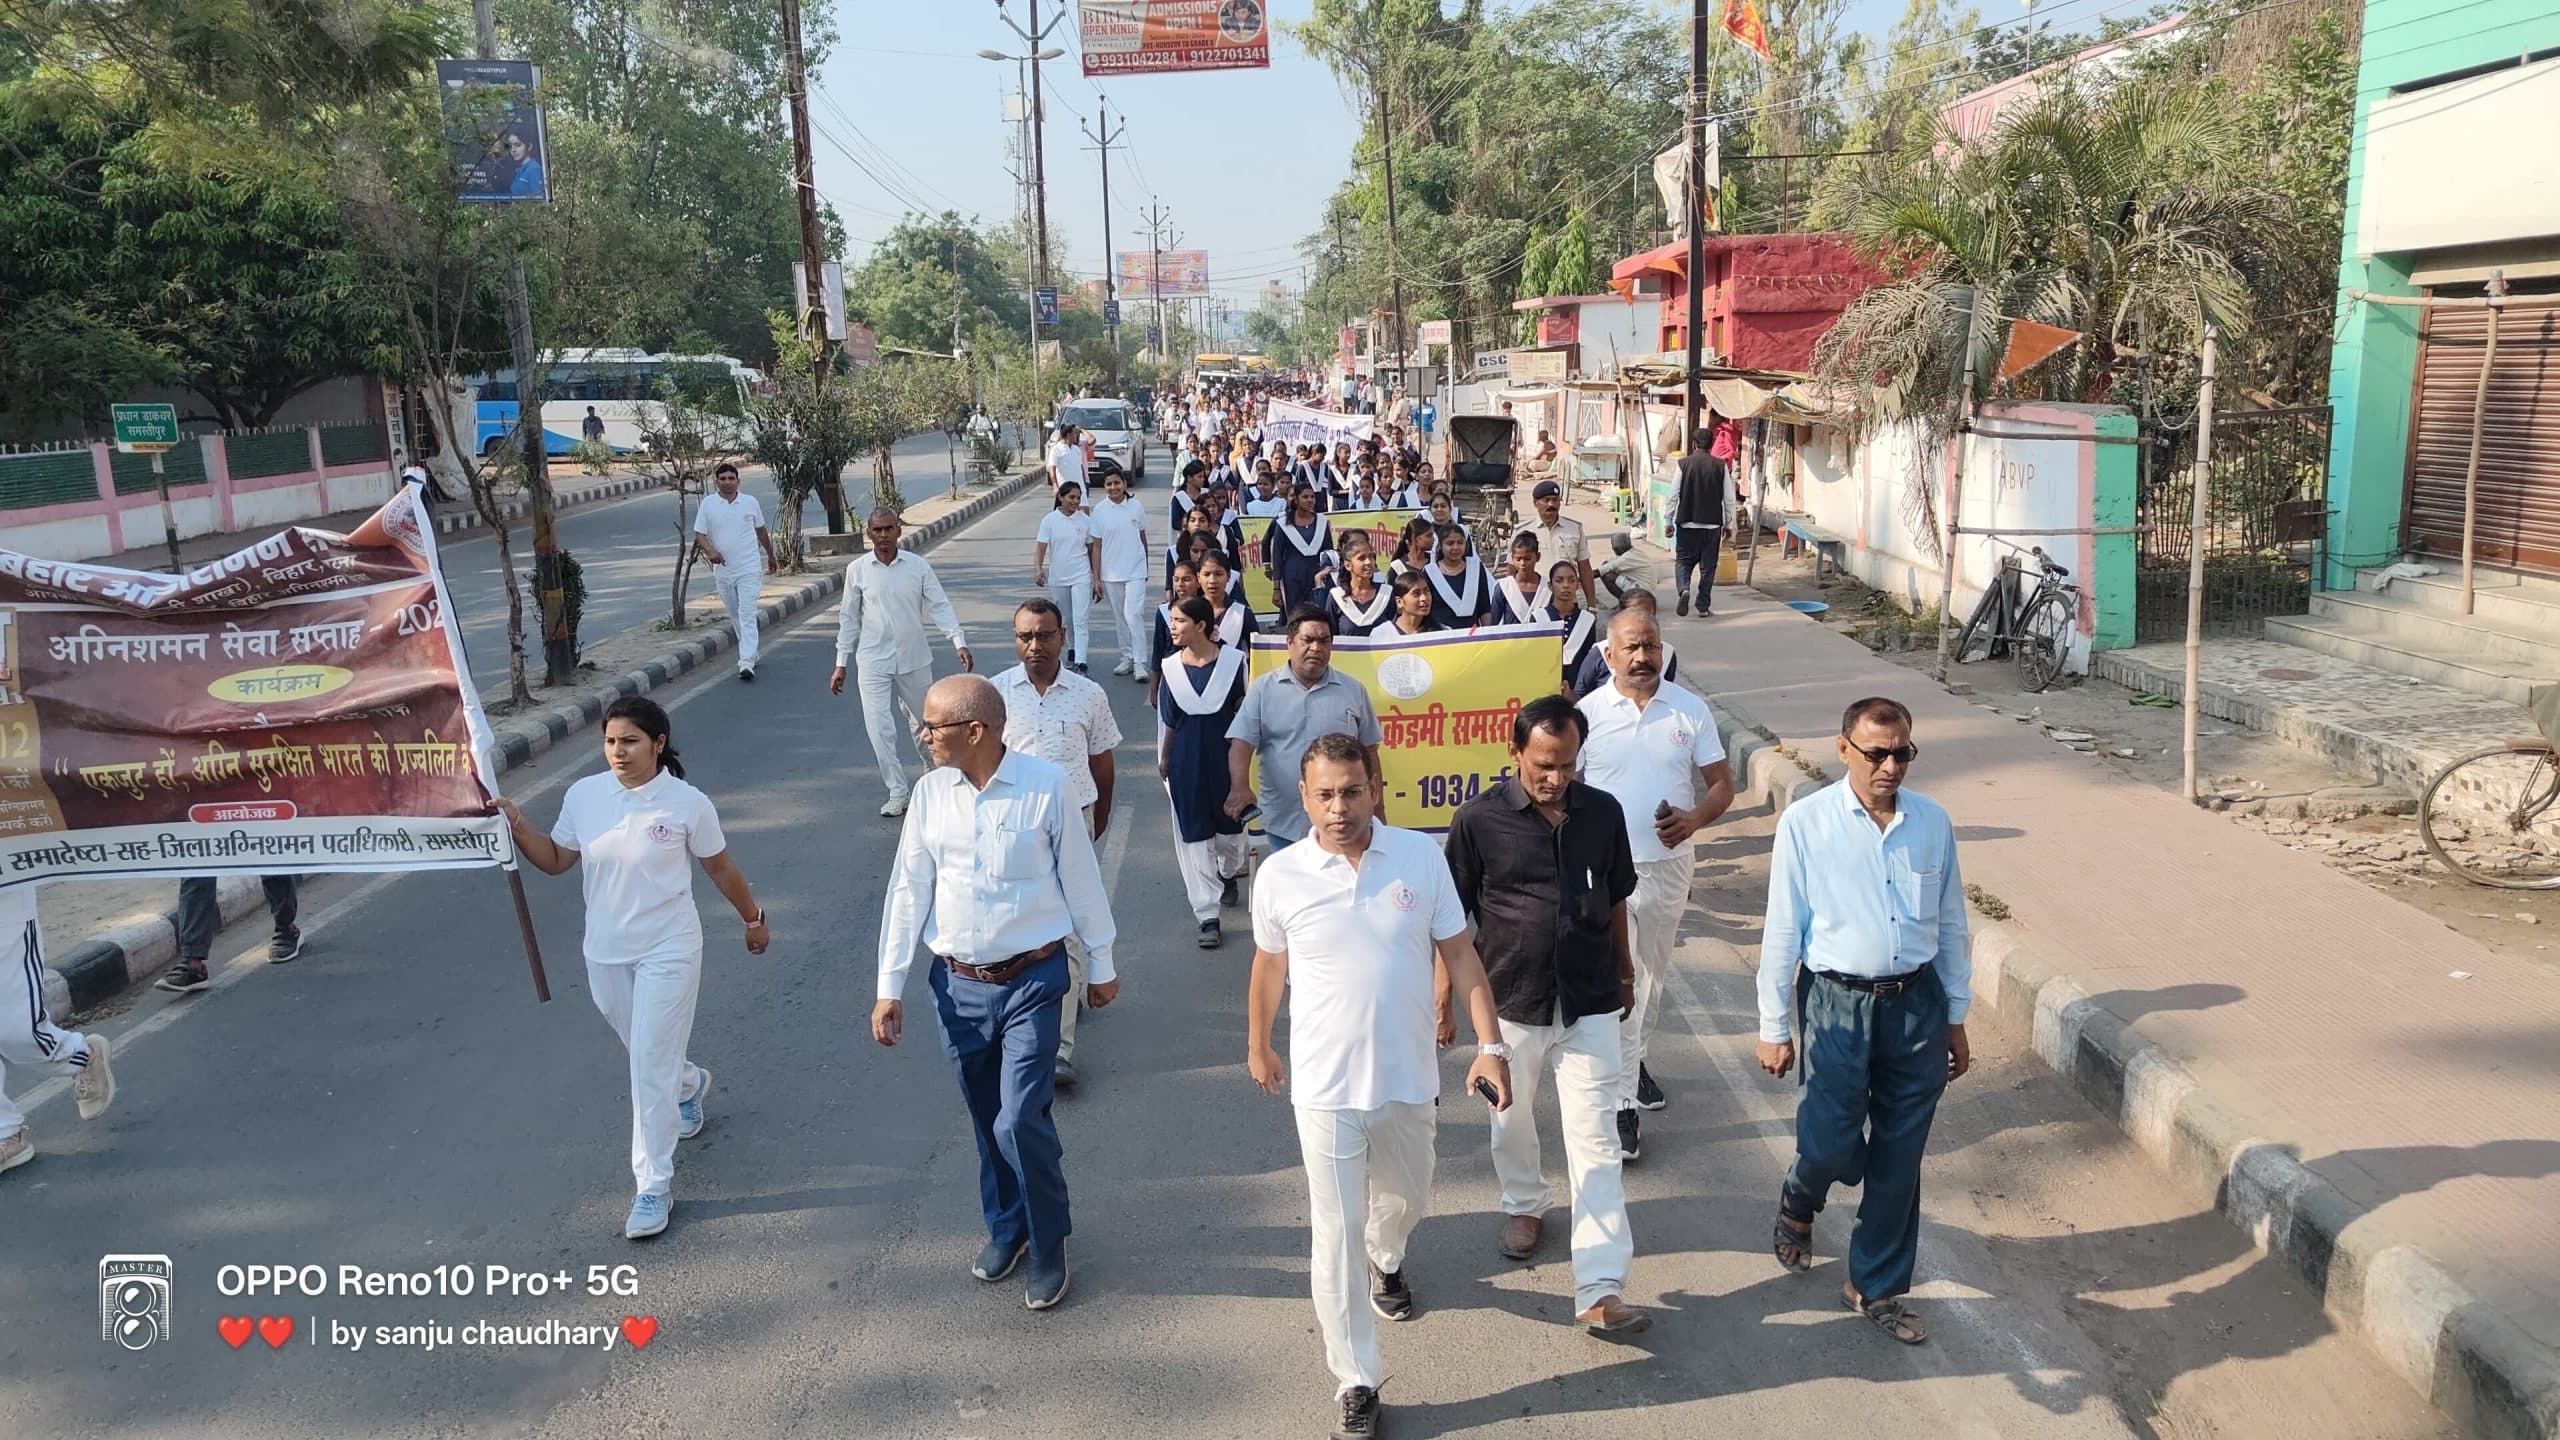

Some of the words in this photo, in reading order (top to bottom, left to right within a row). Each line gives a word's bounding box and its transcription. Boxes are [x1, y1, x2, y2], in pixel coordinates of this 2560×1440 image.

[1149, 1, 1217, 16] ADMISSIONS
[1083, 25, 1108, 37] OPEN
[1109, 24, 1139, 35] MINDS
[1101, 52, 1177, 67] 9931042284
[1190, 47, 1266, 63] 9122701341
[1478, 354, 1508, 368] CSC
[116, 411, 139, 422] प्रधान
[141, 410, 172, 421] डाकघर
[126, 422, 166, 440] समस्तीपुर
[1999, 460, 2035, 491] ABVP
[48, 623, 210, 664] अग्निशमन
[220, 622, 281, 660] सेवा
[289, 619, 365, 655] सप्ताह
[236, 669, 325, 695] कार्यक्रम
[1377, 703, 1448, 749] केडमी
[79, 761, 149, 800] एकजुट
[192, 739, 245, 783] अग्नि
[247, 733, 316, 793] सुरक्षित
[319, 743, 366, 777] भारत
[366, 730, 392, 777] को
[394, 728, 457, 777] प्रज्वलित
[1417, 773, 1480, 809] 1934
[213, 806, 278, 821] आयोजक
